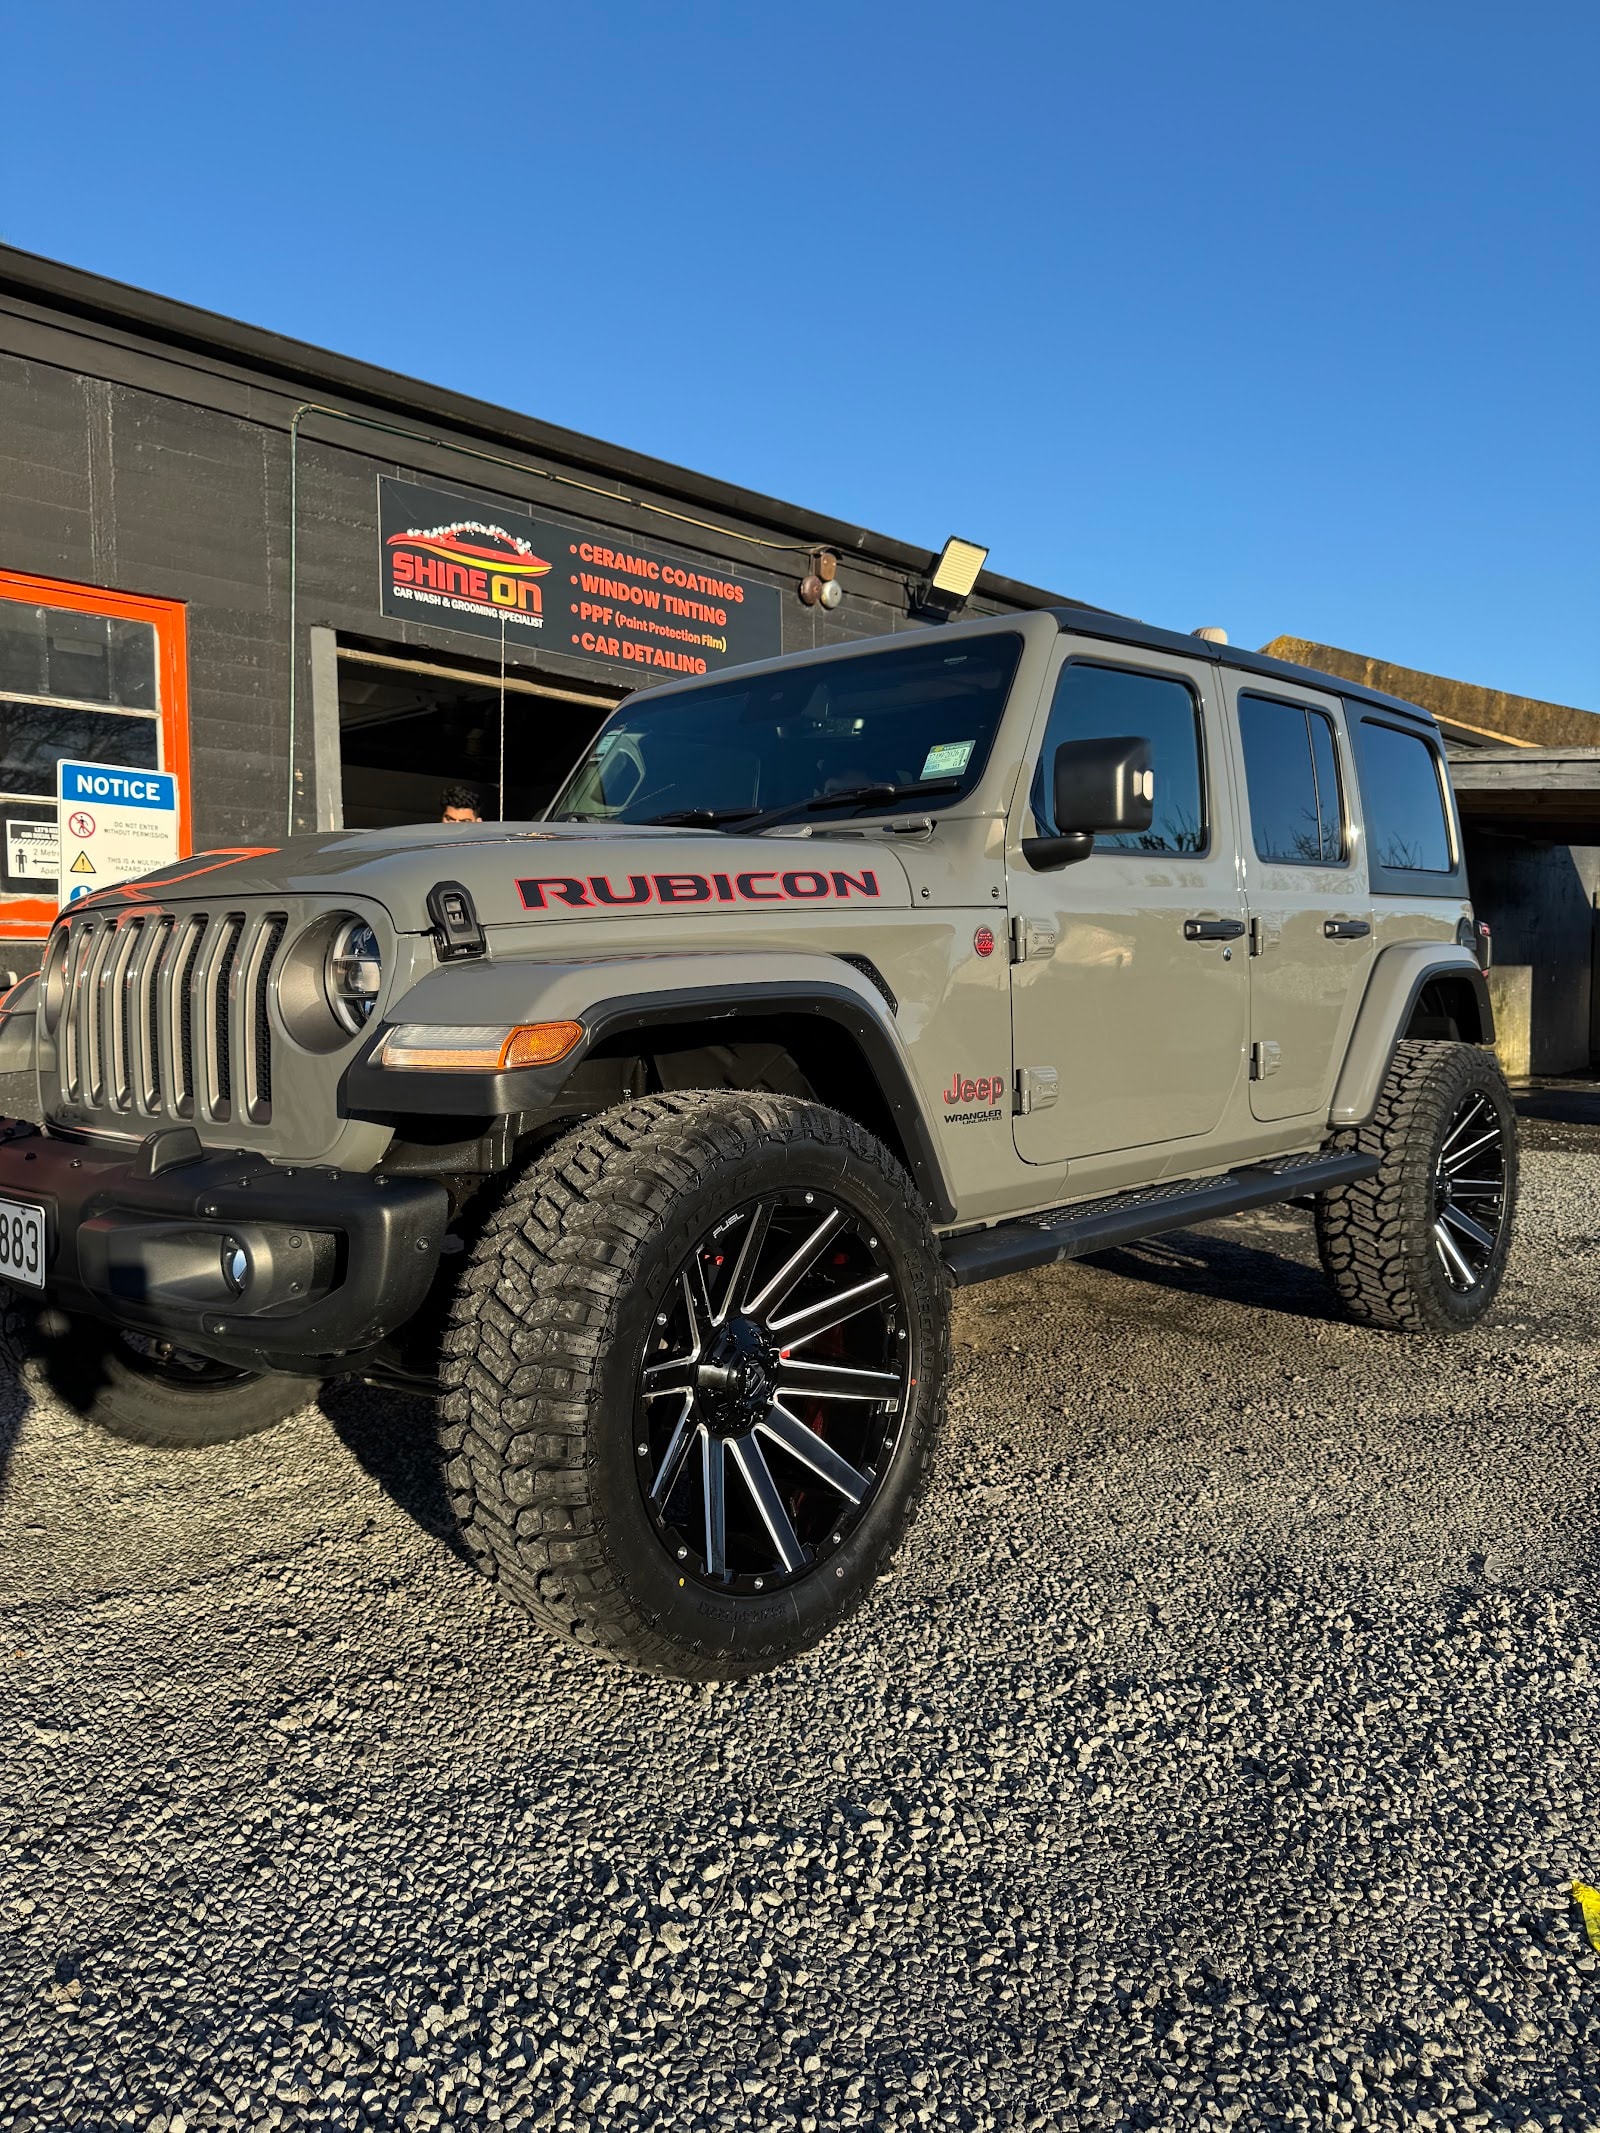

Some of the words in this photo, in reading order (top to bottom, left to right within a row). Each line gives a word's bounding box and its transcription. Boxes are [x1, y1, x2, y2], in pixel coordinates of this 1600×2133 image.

[392, 552, 488, 600] SHINE
[491, 575, 543, 613] ON
[579, 543, 660, 580] CERAMIC
[661, 566, 744, 603] COATINGS
[393, 586, 413, 600] CAR
[414, 590, 442, 608] WASH
[441, 597, 451, 608] &
[451, 599, 498, 619] GROOMING
[498, 608, 544, 629] SPECIALIST
[580, 572, 660, 610] WINDOW
[662, 594, 727, 626] TINTING
[580, 602, 613, 626] PPF
[614, 611, 648, 632] (Paint
[648, 622, 701, 645] Protection
[701, 634, 727, 653] Film)
[581, 632, 620, 657] CAR
[622, 641, 707, 675] DETAILING
[77, 774, 161, 801] NOTICE
[104, 828, 131, 836] WITHOUT
[132, 831, 169, 839] PERMISSION
[114, 821, 124, 829] DO
[125, 822, 138, 830] NOT
[139, 823, 159, 831] ENTER
[33, 848, 39, 856] 2
[514, 871, 881, 910] RUBICON
[943, 1072, 1005, 1105] Jeep
[943, 1109, 1002, 1123] WRANGLER
[962, 1116, 1003, 1125] UNLIMITED
[0, 1213, 38, 1273] 883
[712, 1213, 745, 1239] FUEL
[902, 1247, 936, 1384] RENEGADE
